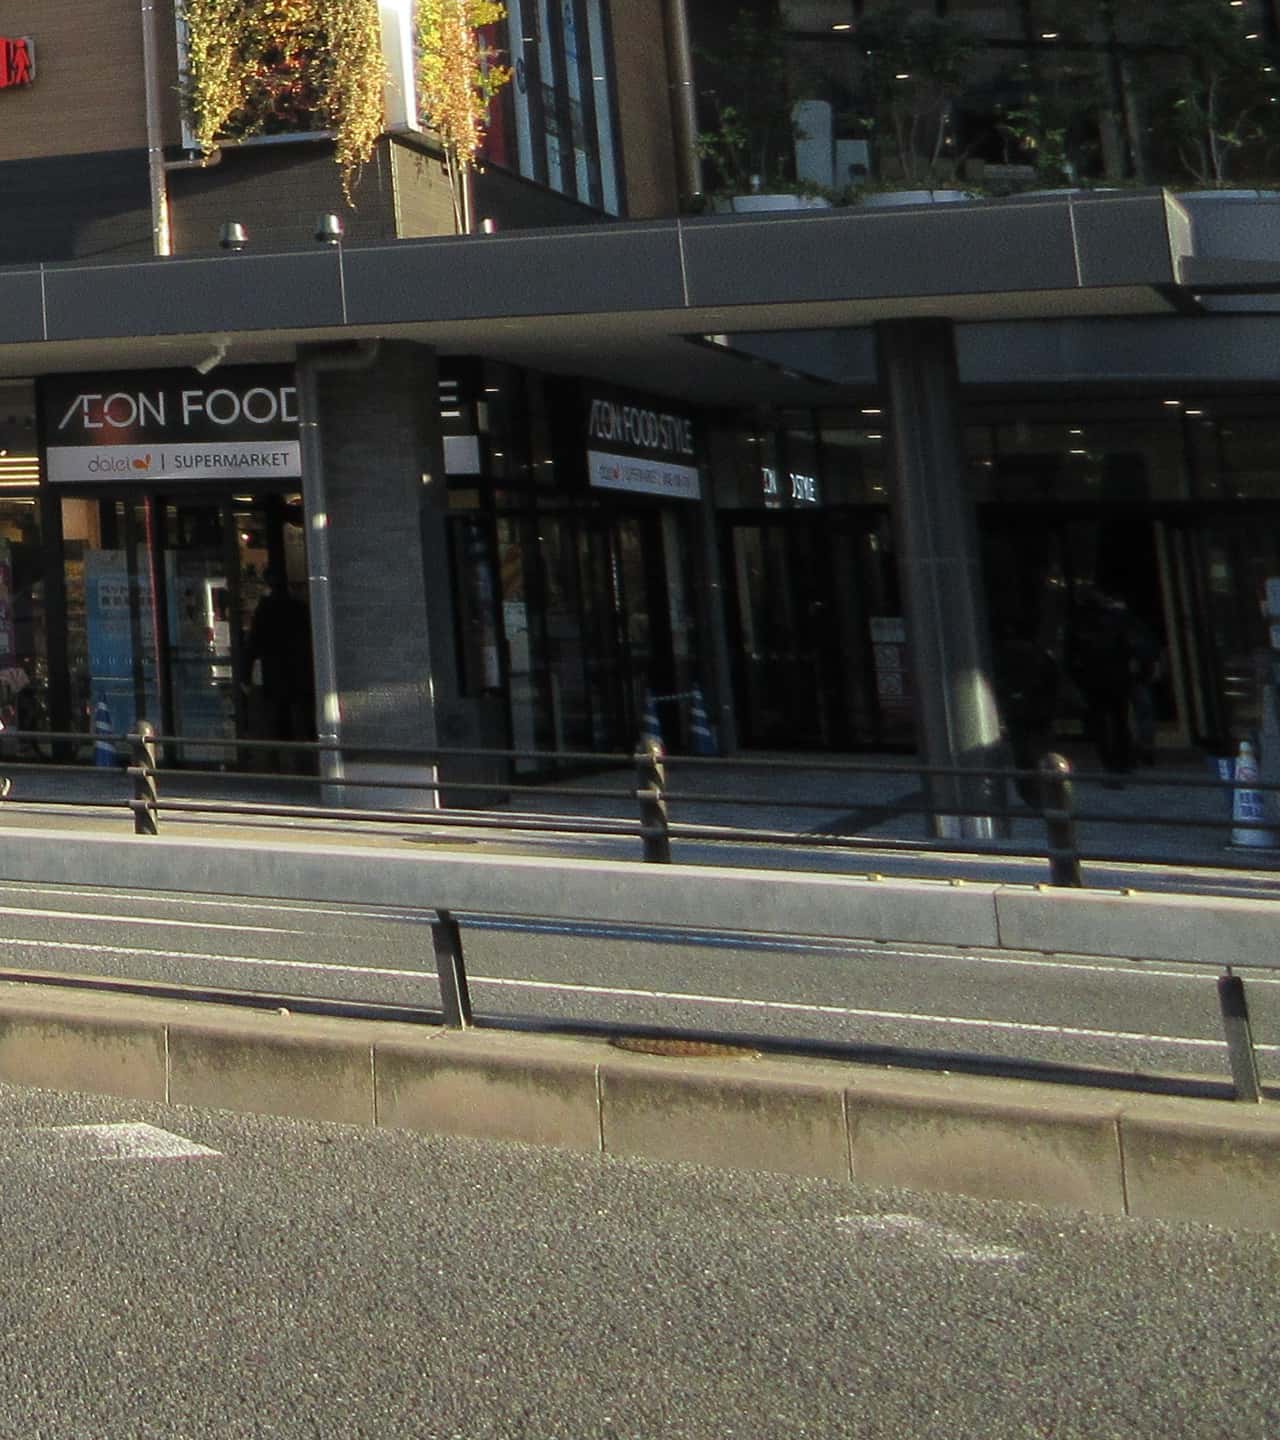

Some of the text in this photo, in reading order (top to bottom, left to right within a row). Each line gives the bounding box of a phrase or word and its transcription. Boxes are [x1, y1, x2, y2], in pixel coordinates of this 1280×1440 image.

[623, 406, 658, 447] FOOD
[659, 413, 694, 454] STYLE
[174, 453, 290, 469] SUPERMARKET
